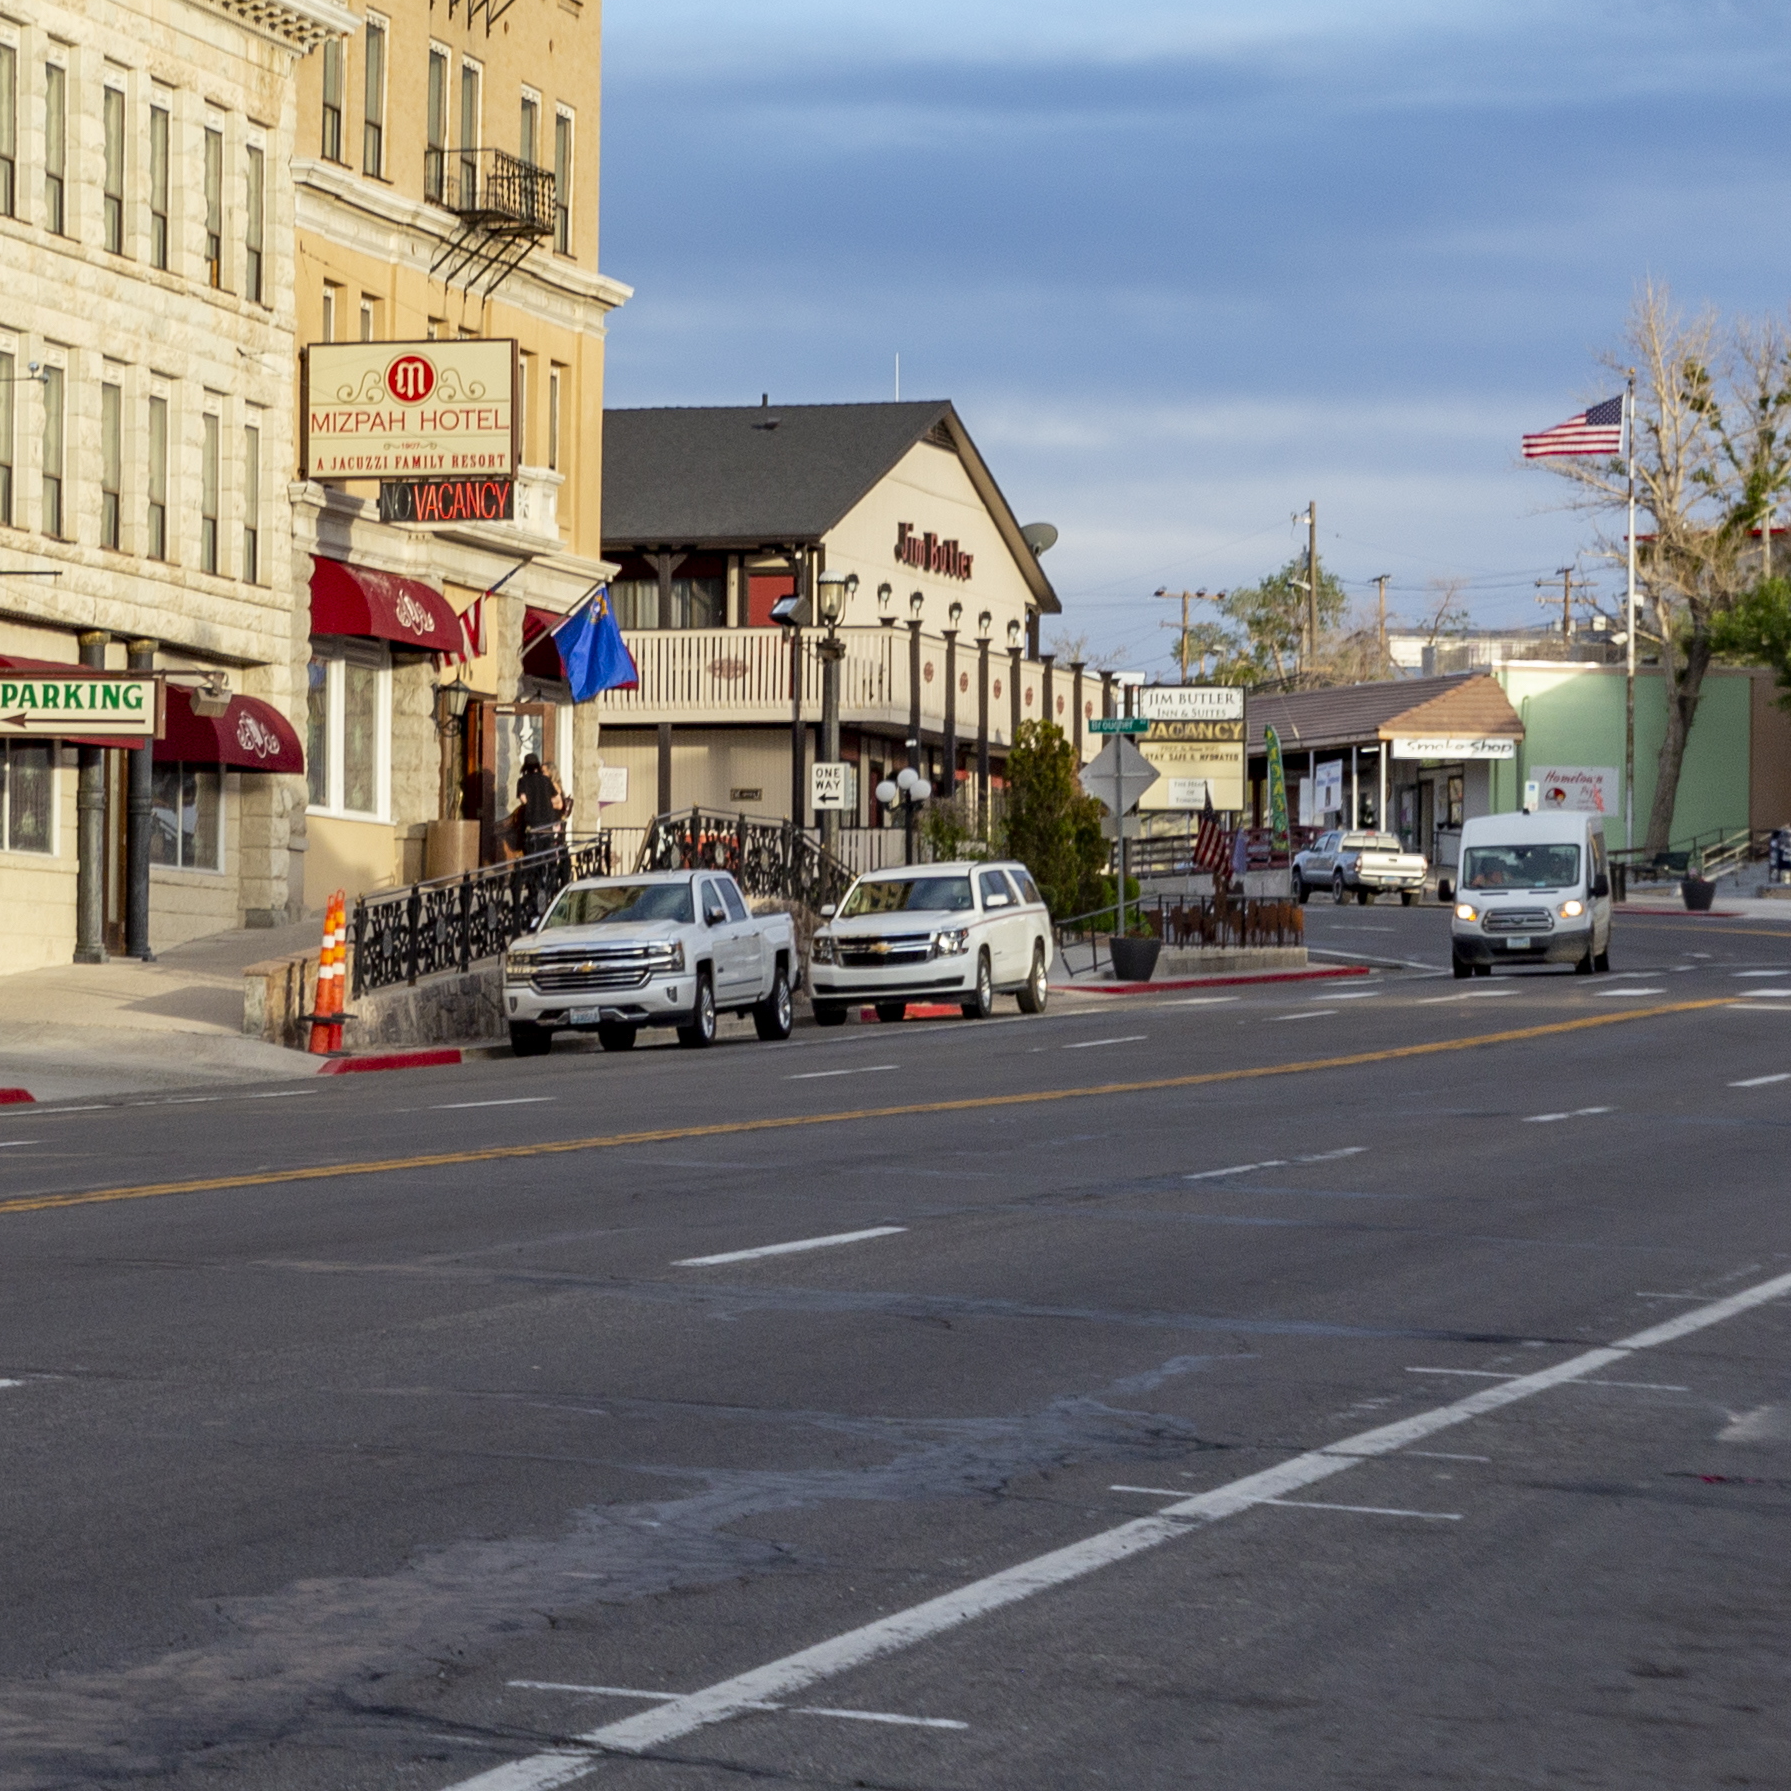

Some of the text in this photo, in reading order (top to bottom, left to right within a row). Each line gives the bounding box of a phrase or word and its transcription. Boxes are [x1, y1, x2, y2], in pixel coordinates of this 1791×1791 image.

[311, 408, 510, 434] MIZPAH HOTEL
[317, 453, 506, 471] A JACUZZI FAMILY RESORT
[382, 481, 510, 521] NO VACANCY
[924, 532, 974, 582] Butler
[1, 682, 145, 710] PARKING
[1149, 693, 1235, 707] JIM BUTLER
[1471, 740, 1512, 754] Shop
[815, 768, 841, 778] ONE
[815, 780, 841, 790] WAY
